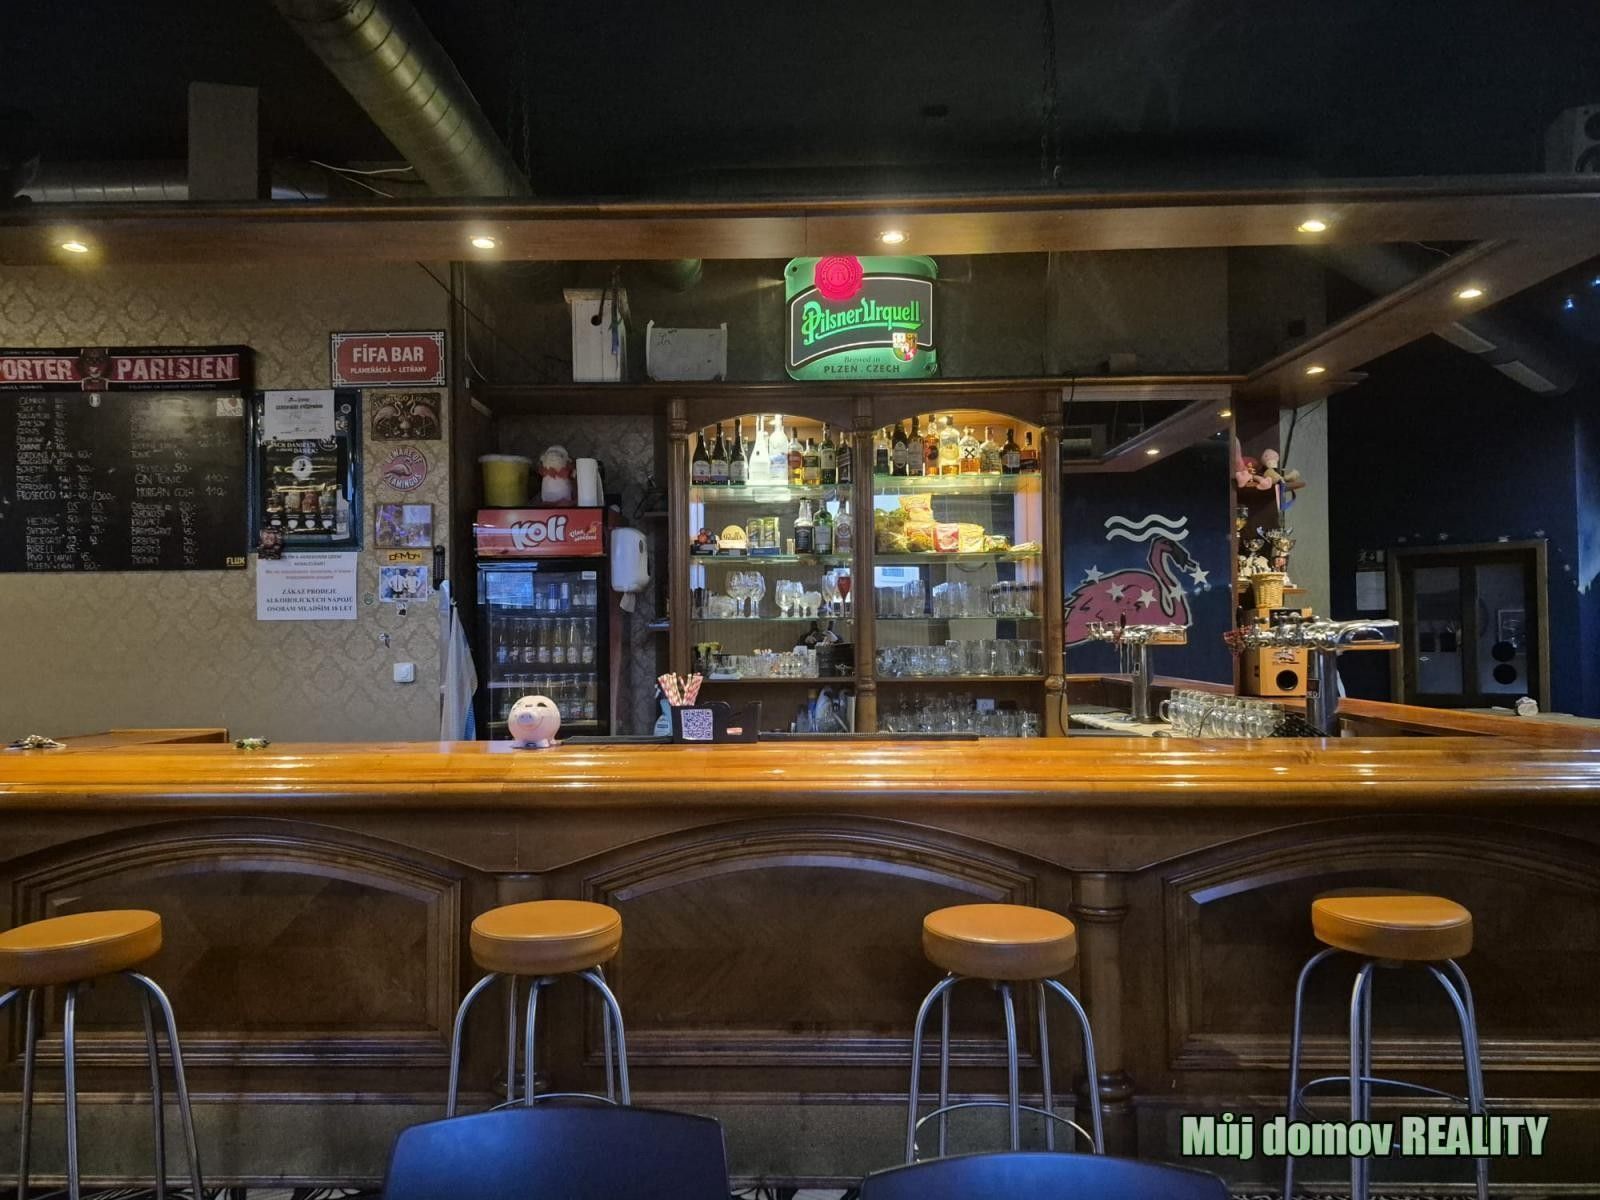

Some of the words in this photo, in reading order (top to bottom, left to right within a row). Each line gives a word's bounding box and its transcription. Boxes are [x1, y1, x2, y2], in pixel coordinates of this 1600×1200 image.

[801, 300, 863, 346] Pilsner
[861, 297, 921, 331] Urquell
[391, 346, 424, 363] BAR
[0, 358, 74, 381] ORTER
[117, 357, 235, 381] PARISIEN
[866, 364, 900, 373] CZECH
